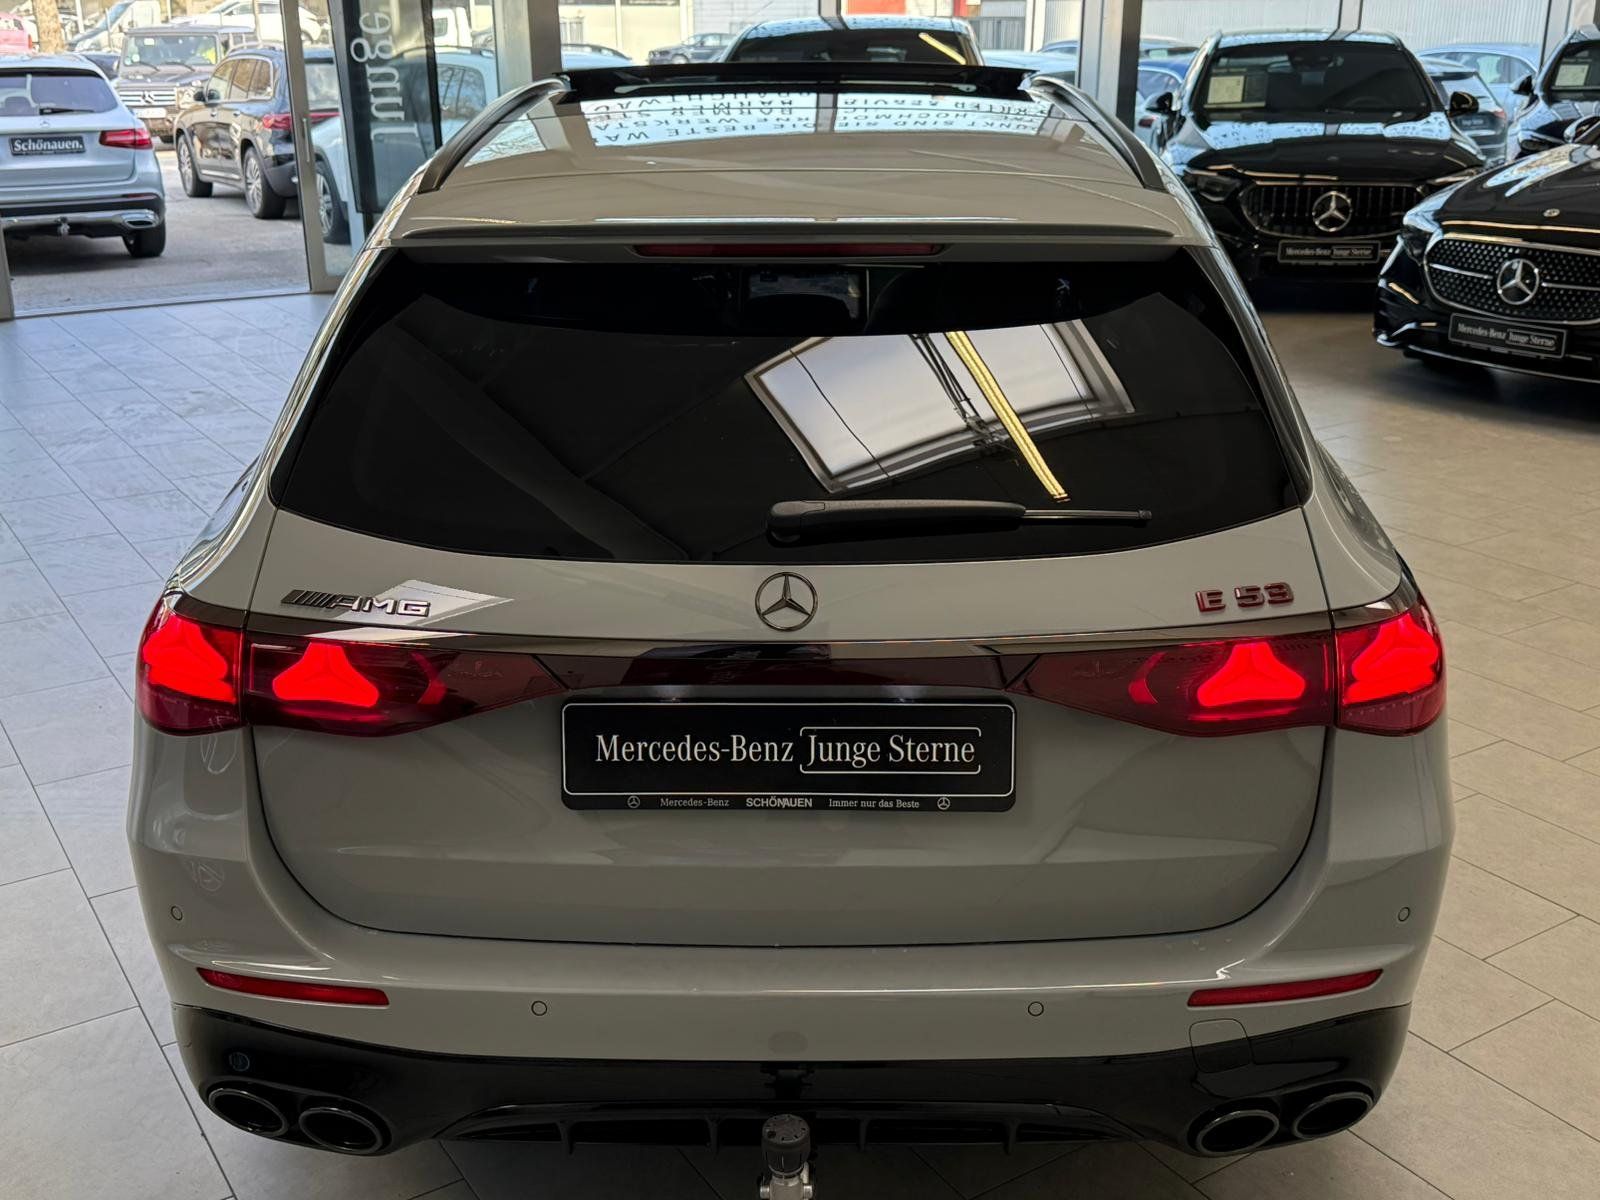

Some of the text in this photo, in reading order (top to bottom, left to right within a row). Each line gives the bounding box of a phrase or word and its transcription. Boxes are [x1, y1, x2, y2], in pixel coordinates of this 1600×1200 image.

[328, 595, 431, 617] AMG
[1195, 582, 1295, 613] E 53
[595, 734, 975, 769] Mercedes-Benz Junge Sterne
[660, 795, 920, 809] Mercedes-Benz SCHÖNAUEN Immer nur das Beste
